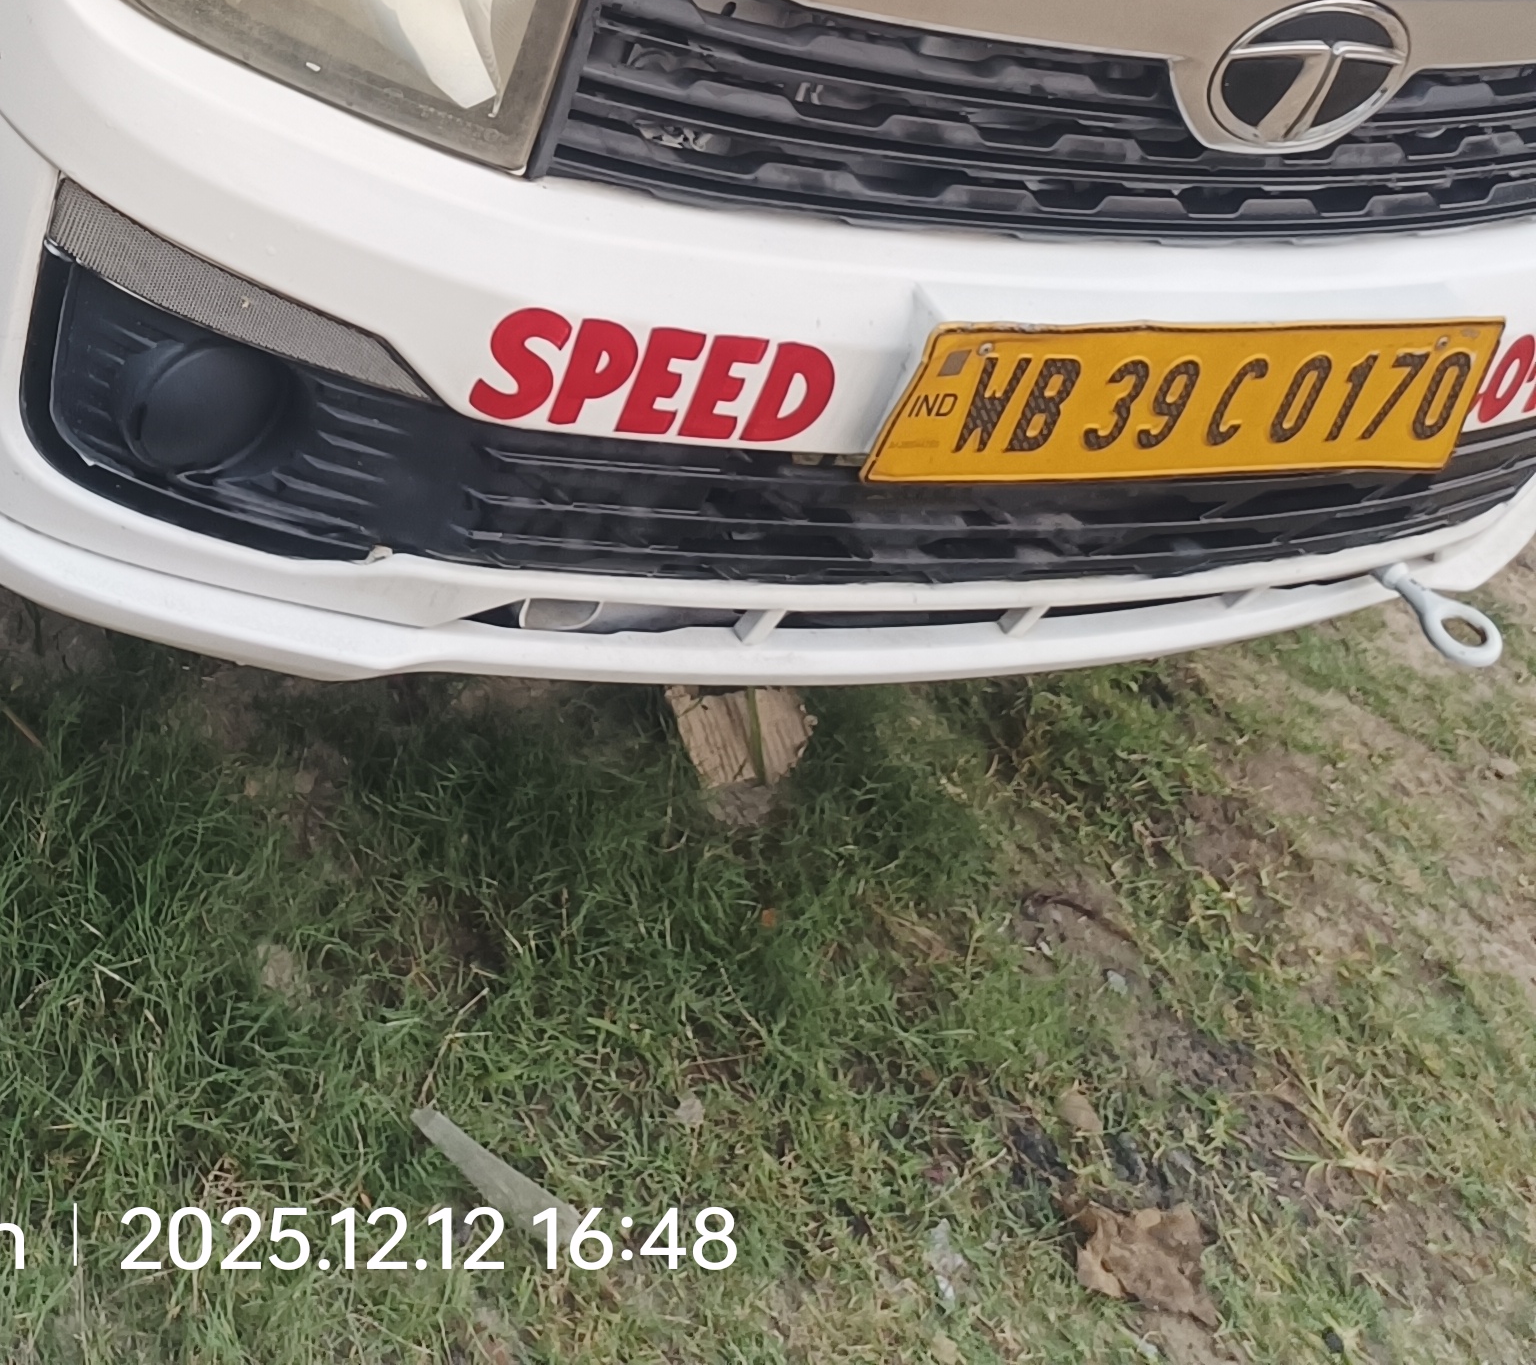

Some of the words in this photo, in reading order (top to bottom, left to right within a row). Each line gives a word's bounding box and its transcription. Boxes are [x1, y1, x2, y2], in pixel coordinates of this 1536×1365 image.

[468, 306, 836, 443] SPEED
[907, 393, 959, 418] IND
[952, 354, 1082, 453] WB
[1081, 357, 1201, 452] 39
[1204, 359, 1269, 447] C
[1267, 349, 1473, 443] 0170
